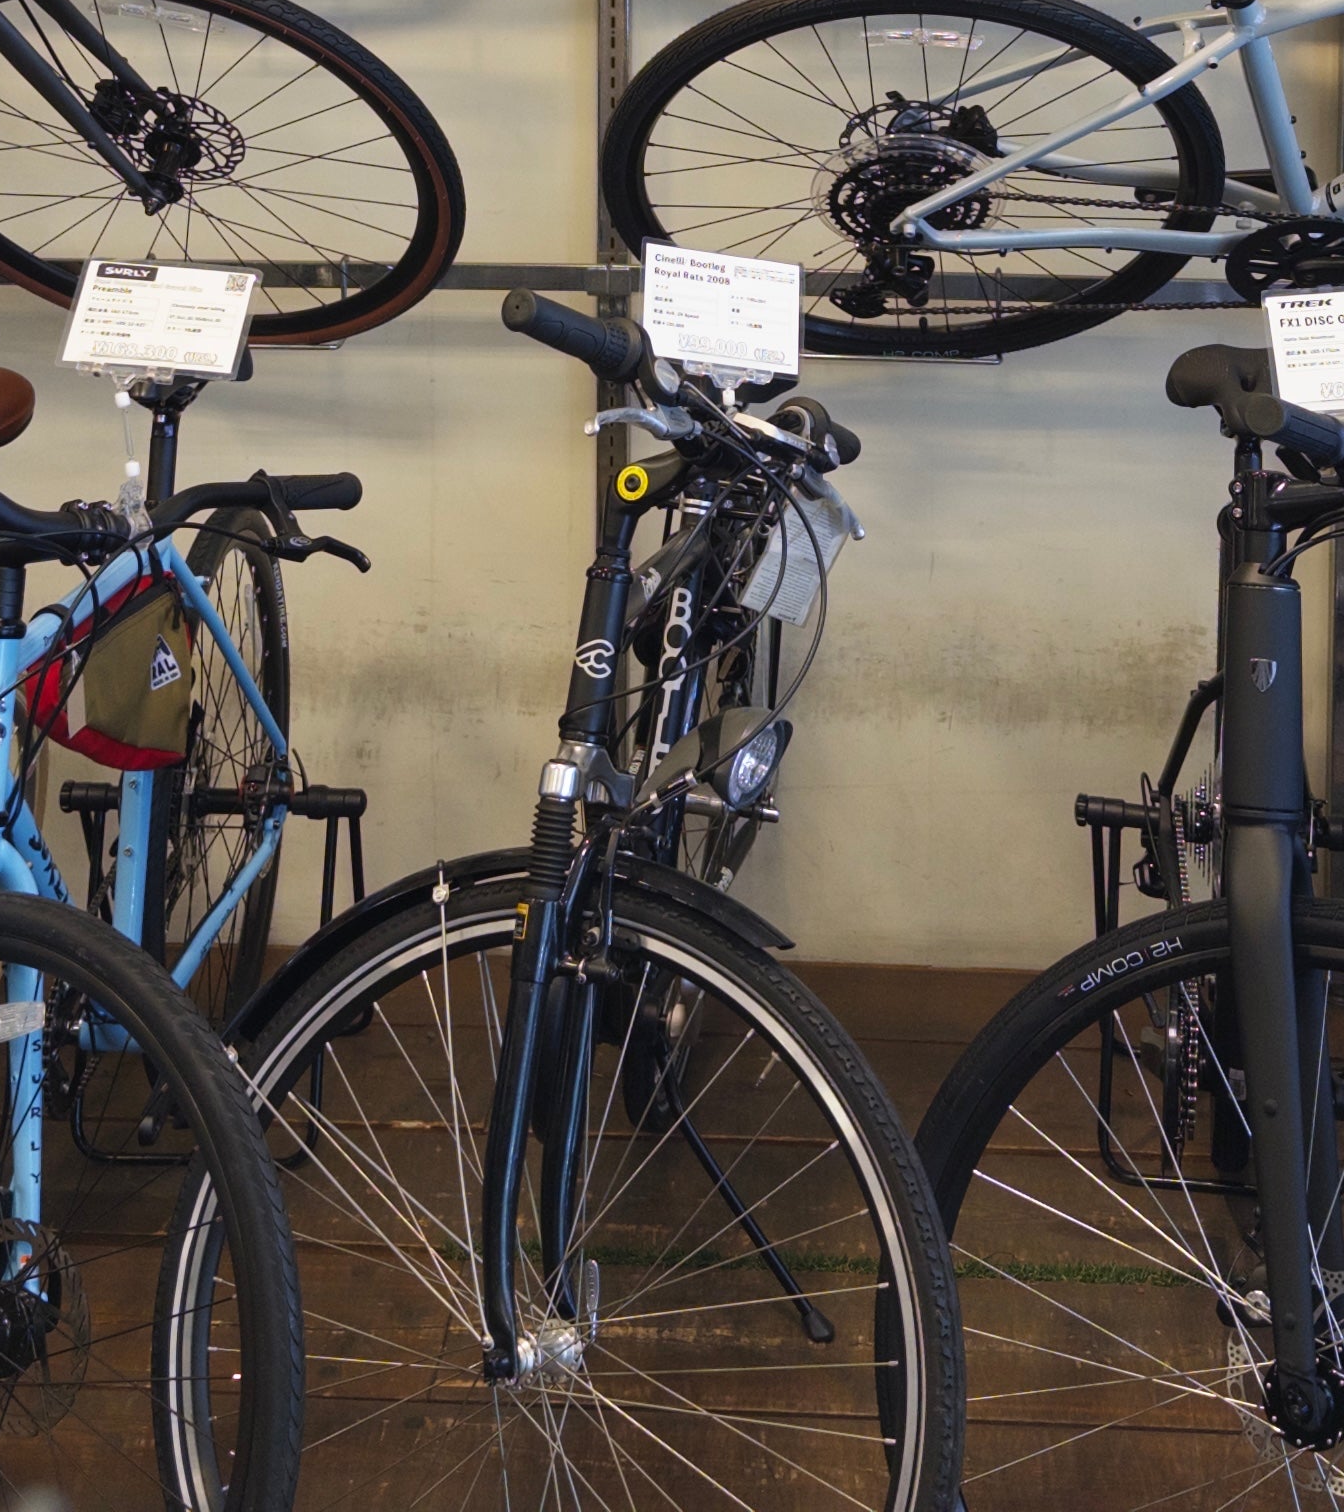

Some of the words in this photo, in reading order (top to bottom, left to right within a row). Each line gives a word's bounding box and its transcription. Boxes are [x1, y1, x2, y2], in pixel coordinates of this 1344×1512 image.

[105, 266, 151, 278] SURLY
[690, 259, 726, 273] Bootleg
[655, 267, 681, 279] Royal
[684, 272, 704, 282] Rats
[706, 275, 730, 285] 2008
[92, 285, 133, 295] Preamble
[1278, 298, 1333, 309] TREK
[1280, 318, 1301, 328] FX1
[1305, 316, 1334, 326] DISC
[1149, 936, 1183, 958] H2
[1080, 951, 1144, 991] COMP
[29, 1039, 42, 1184] SURLY
